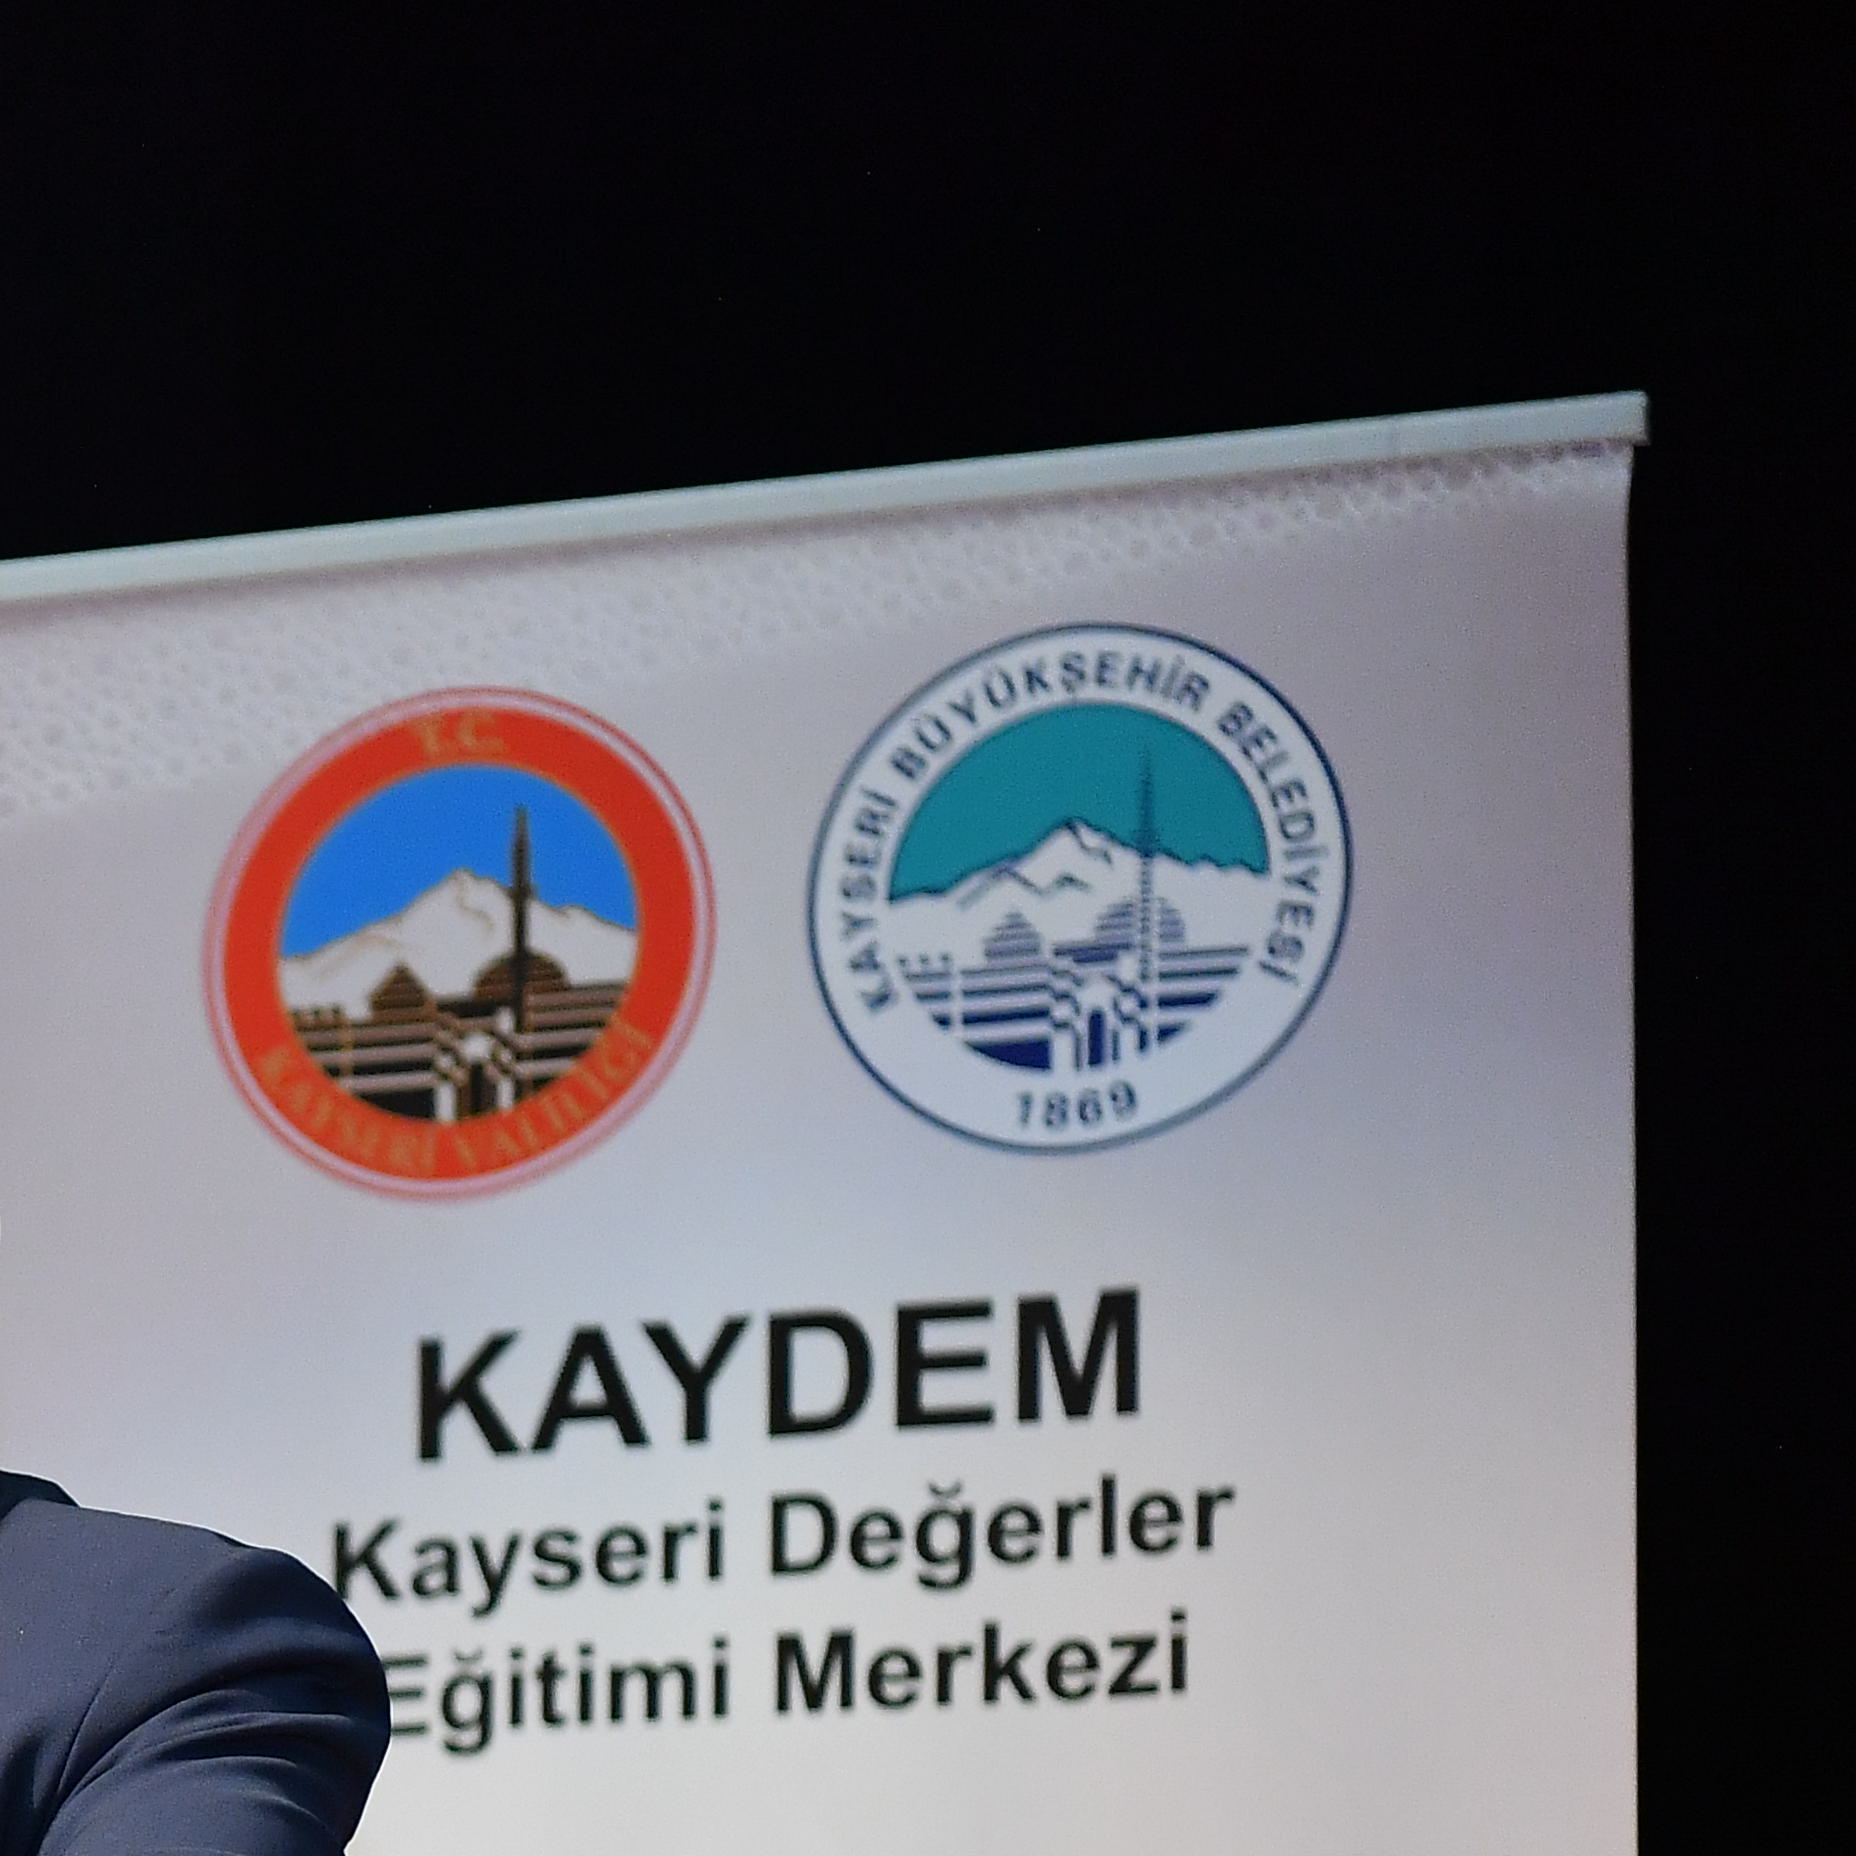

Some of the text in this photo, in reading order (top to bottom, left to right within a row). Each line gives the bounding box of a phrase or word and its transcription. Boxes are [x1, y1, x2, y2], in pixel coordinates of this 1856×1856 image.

[837, 650, 1330, 1017] KAYSERİ BÜYÜKŞEHİR BELEDİYESİ
[1015, 1079, 1139, 1130] 1869
[414, 1286, 1142, 1463] KAYDEM
[329, 1472, 1237, 1618] Kayseri Değerler
[380, 1607, 1190, 1757] Eğitimi Merkezi
